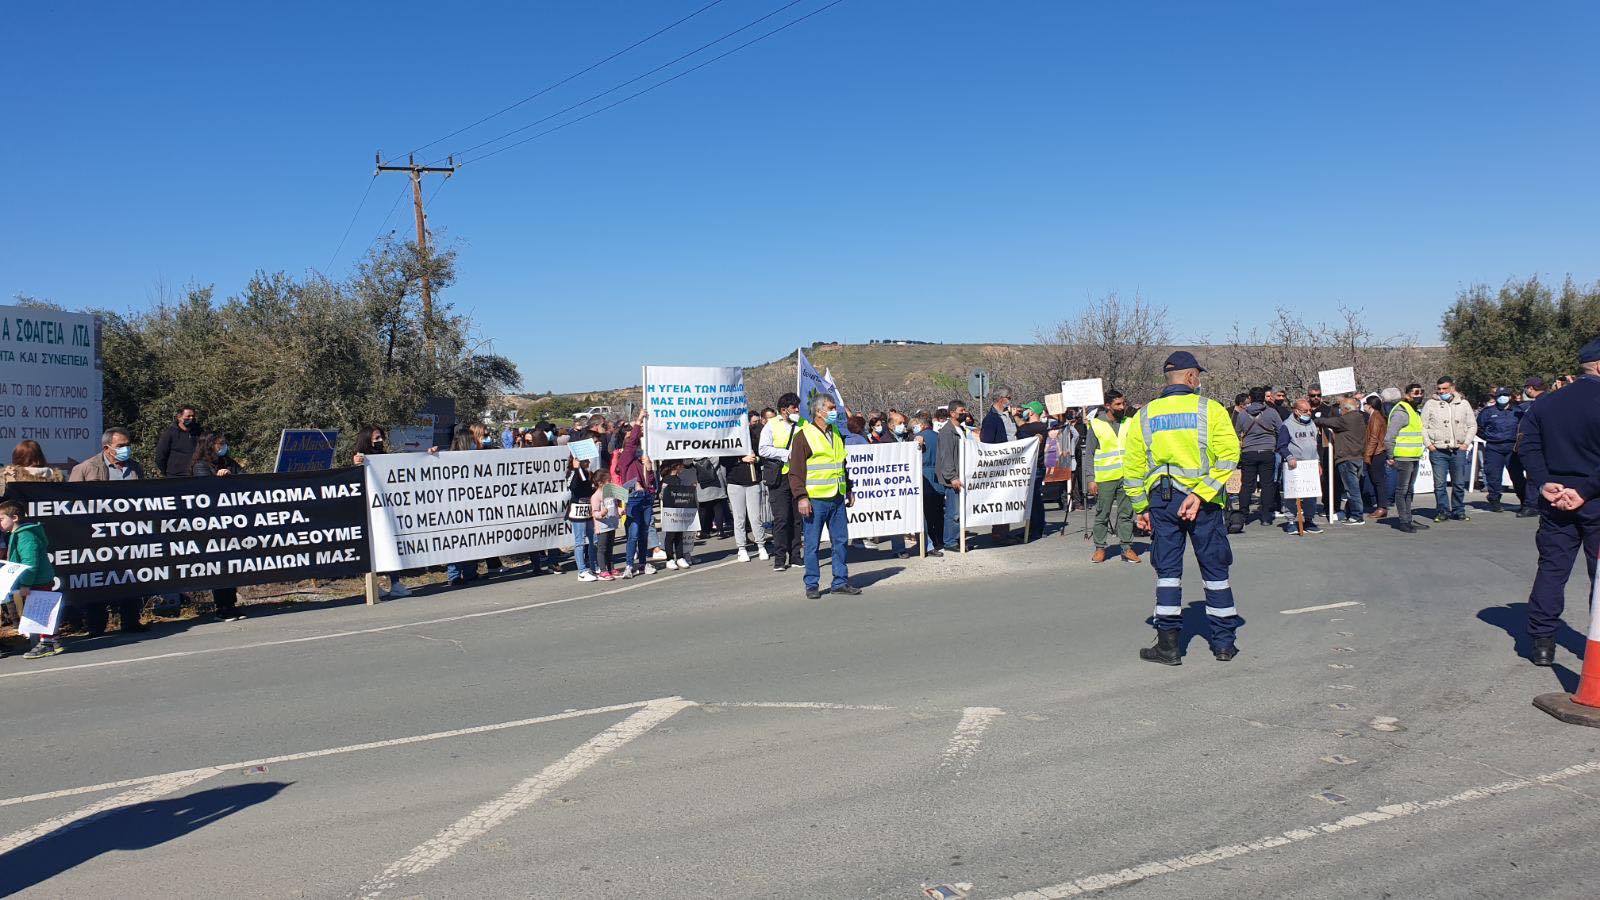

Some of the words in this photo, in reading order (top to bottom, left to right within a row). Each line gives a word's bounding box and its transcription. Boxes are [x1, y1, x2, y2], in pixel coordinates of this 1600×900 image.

[16, 318, 65, 345] ΣΦΑΓΕΙΑ
[72, 324, 91, 347] ΛΤΔ
[20, 352, 37, 363] ΚΑΙ
[41, 352, 89, 367] ΣΥΝΕΠΕΙΑ
[11, 384, 22, 396] ΤΟ
[26, 385, 41, 397] ΠΙΟ
[45, 385, 88, 399] ΣΥΓΧΡΟΝΟ
[647, 384, 655, 393] Η
[658, 384, 691, 393] ΥΓΕΙΑ
[695, 385, 716, 393] ΤΩΝ
[650, 397, 674, 405] ΜΑΣ
[677, 397, 707, 405] ΕΙΝΑΙ
[21, 406, 29, 418] &
[35, 406, 88, 419] ΚΟΠΤΗΡΙΟ
[653, 409, 676, 418] ΤΩΝ
[666, 420, 741, 430] ΣΥΜΦΕΡΟΝΤΩΝ
[22, 427, 49, 439] ΣΤΗΝ
[55, 428, 90, 440] ΚΥΠΡΟ
[666, 438, 742, 451] ΑΓΡΟΚΗΠΙΑ
[850, 454, 874, 463] ΜΗΝ
[977, 456, 1027, 468] ΑΝΑΠΝΕΟΥΜΕ
[387, 467, 416, 484] ΔΕΝ
[420, 464, 469, 482] ΜΠΟΡΩ
[474, 463, 492, 479] ΝΑ
[496, 460, 550, 477] ΠΙΣΤΕΨΩ
[554, 458, 570, 472] ΟΤ
[972, 471, 987, 479] ΔΕΝ
[1009, 467, 1031, 476] ΠΡΟΣ
[862, 478, 881, 487] ΜΙΑ
[883, 475, 912, 485] ΦΟΡΑ
[968, 479, 1031, 491] ΔΙΑΠΡΑΓΜΑΤΕΥΣ
[371, 492, 411, 508] ΔΙΚΟΣ
[415, 489, 444, 505] ΜΟΥ
[448, 484, 517, 502] ΠΡΟΕΔΡΟΣ
[898, 486, 920, 496] ΜΑΣ
[25, 496, 177, 517] ΙΕΚΔΙΚΟΥΜΕ
[181, 494, 211, 509] ΤΟ
[217, 487, 316, 507] ΔΙΚΑΙΩΜΑ
[321, 483, 362, 499] ΜΑΣ
[972, 502, 1003, 514] ΚΑΤΩ
[1005, 500, 1027, 512] ΜΟΝ
[396, 514, 413, 530] ΤΟ
[417, 510, 474, 528] ΜΕΛΛΟΝ
[478, 507, 505, 523] ΤΩΝ
[507, 501, 558, 519] ΠΑΙΔΙΩΝ
[847, 509, 902, 524] ΛΟΥΝΤΑ
[91, 520, 153, 538] ΣΤΟΝ
[160, 514, 248, 534] ΚΑΘΑΡΟ
[254, 510, 310, 527] ΑΕΡΑ.
[396, 538, 429, 556] ΕΙΝΑΙ
[432, 523, 573, 552] ΠΑΡΑΠΛΗΡΟΦΟΡΗΜΕΝ
[47, 542, 163, 567] ΕΙΛΟΥΜΕ
[169, 540, 199, 557] ΝΑ
[205, 526, 363, 553] ΔΙΑΦΥΛΑΞΟΥΜΕ
[69, 566, 169, 590] ΜΕΛΛΟΝ
[176, 561, 221, 579] ΤΩΝ
[227, 552, 310, 574] ΠΑΙΔΙΩΝ
[316, 548, 361, 565] ΜΑΣ.
